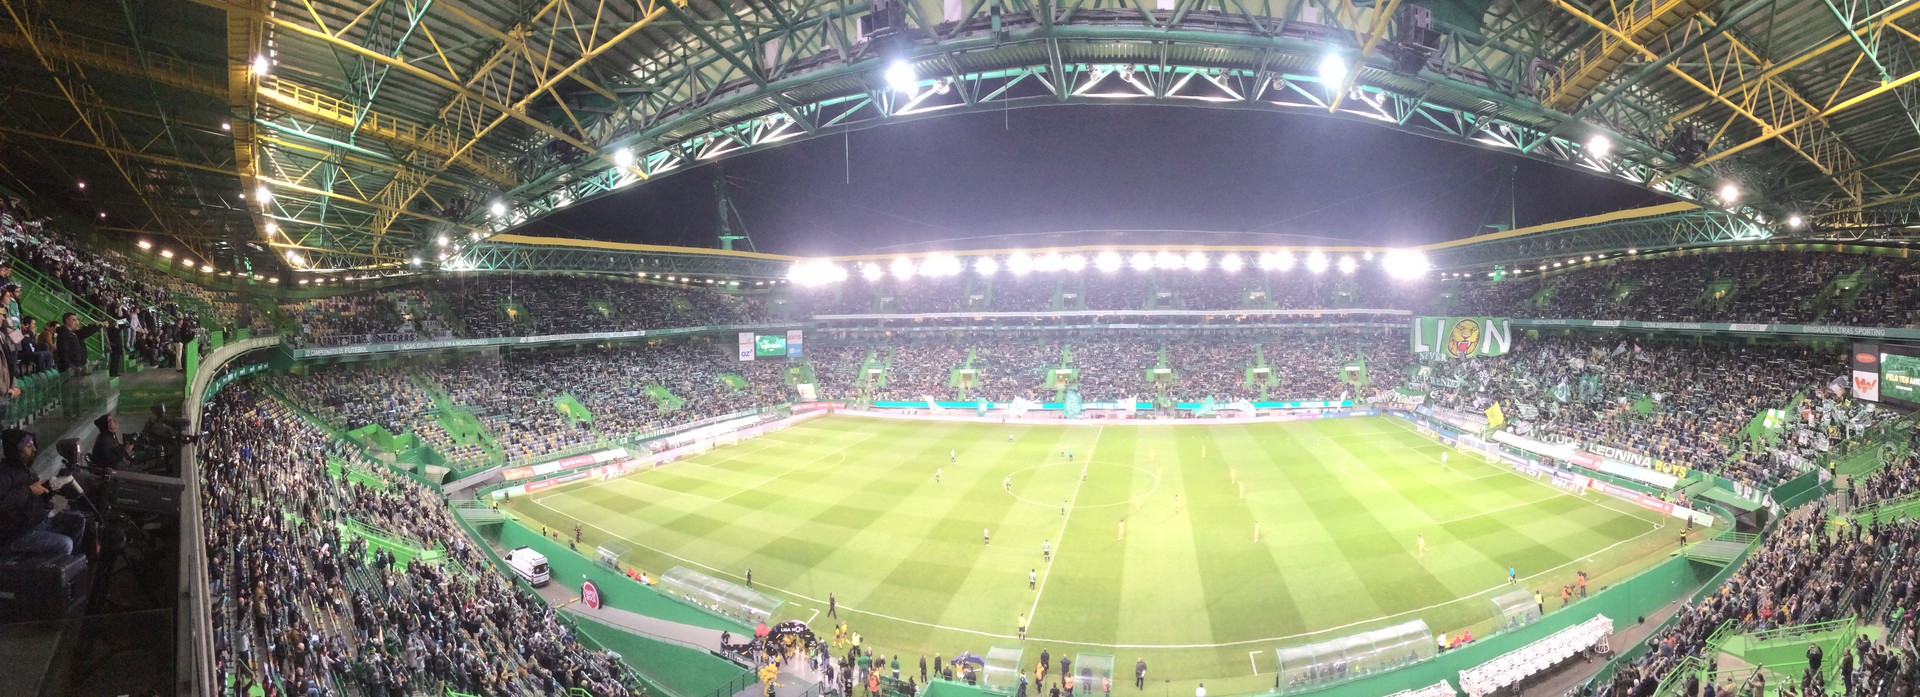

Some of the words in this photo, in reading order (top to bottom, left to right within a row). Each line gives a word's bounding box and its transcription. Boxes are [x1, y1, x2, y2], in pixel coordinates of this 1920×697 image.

[1803, 325, 1829, 333] BRIGADA
[1830, 326, 1854, 335] ULTRAS
[1854, 327, 1885, 336] SPORTING
[1886, 373, 1898, 382] PELO
[1899, 375, 1910, 384] TEU
[1588, 442, 1652, 469] LEONINA
[1655, 460, 1687, 479] BOYS
